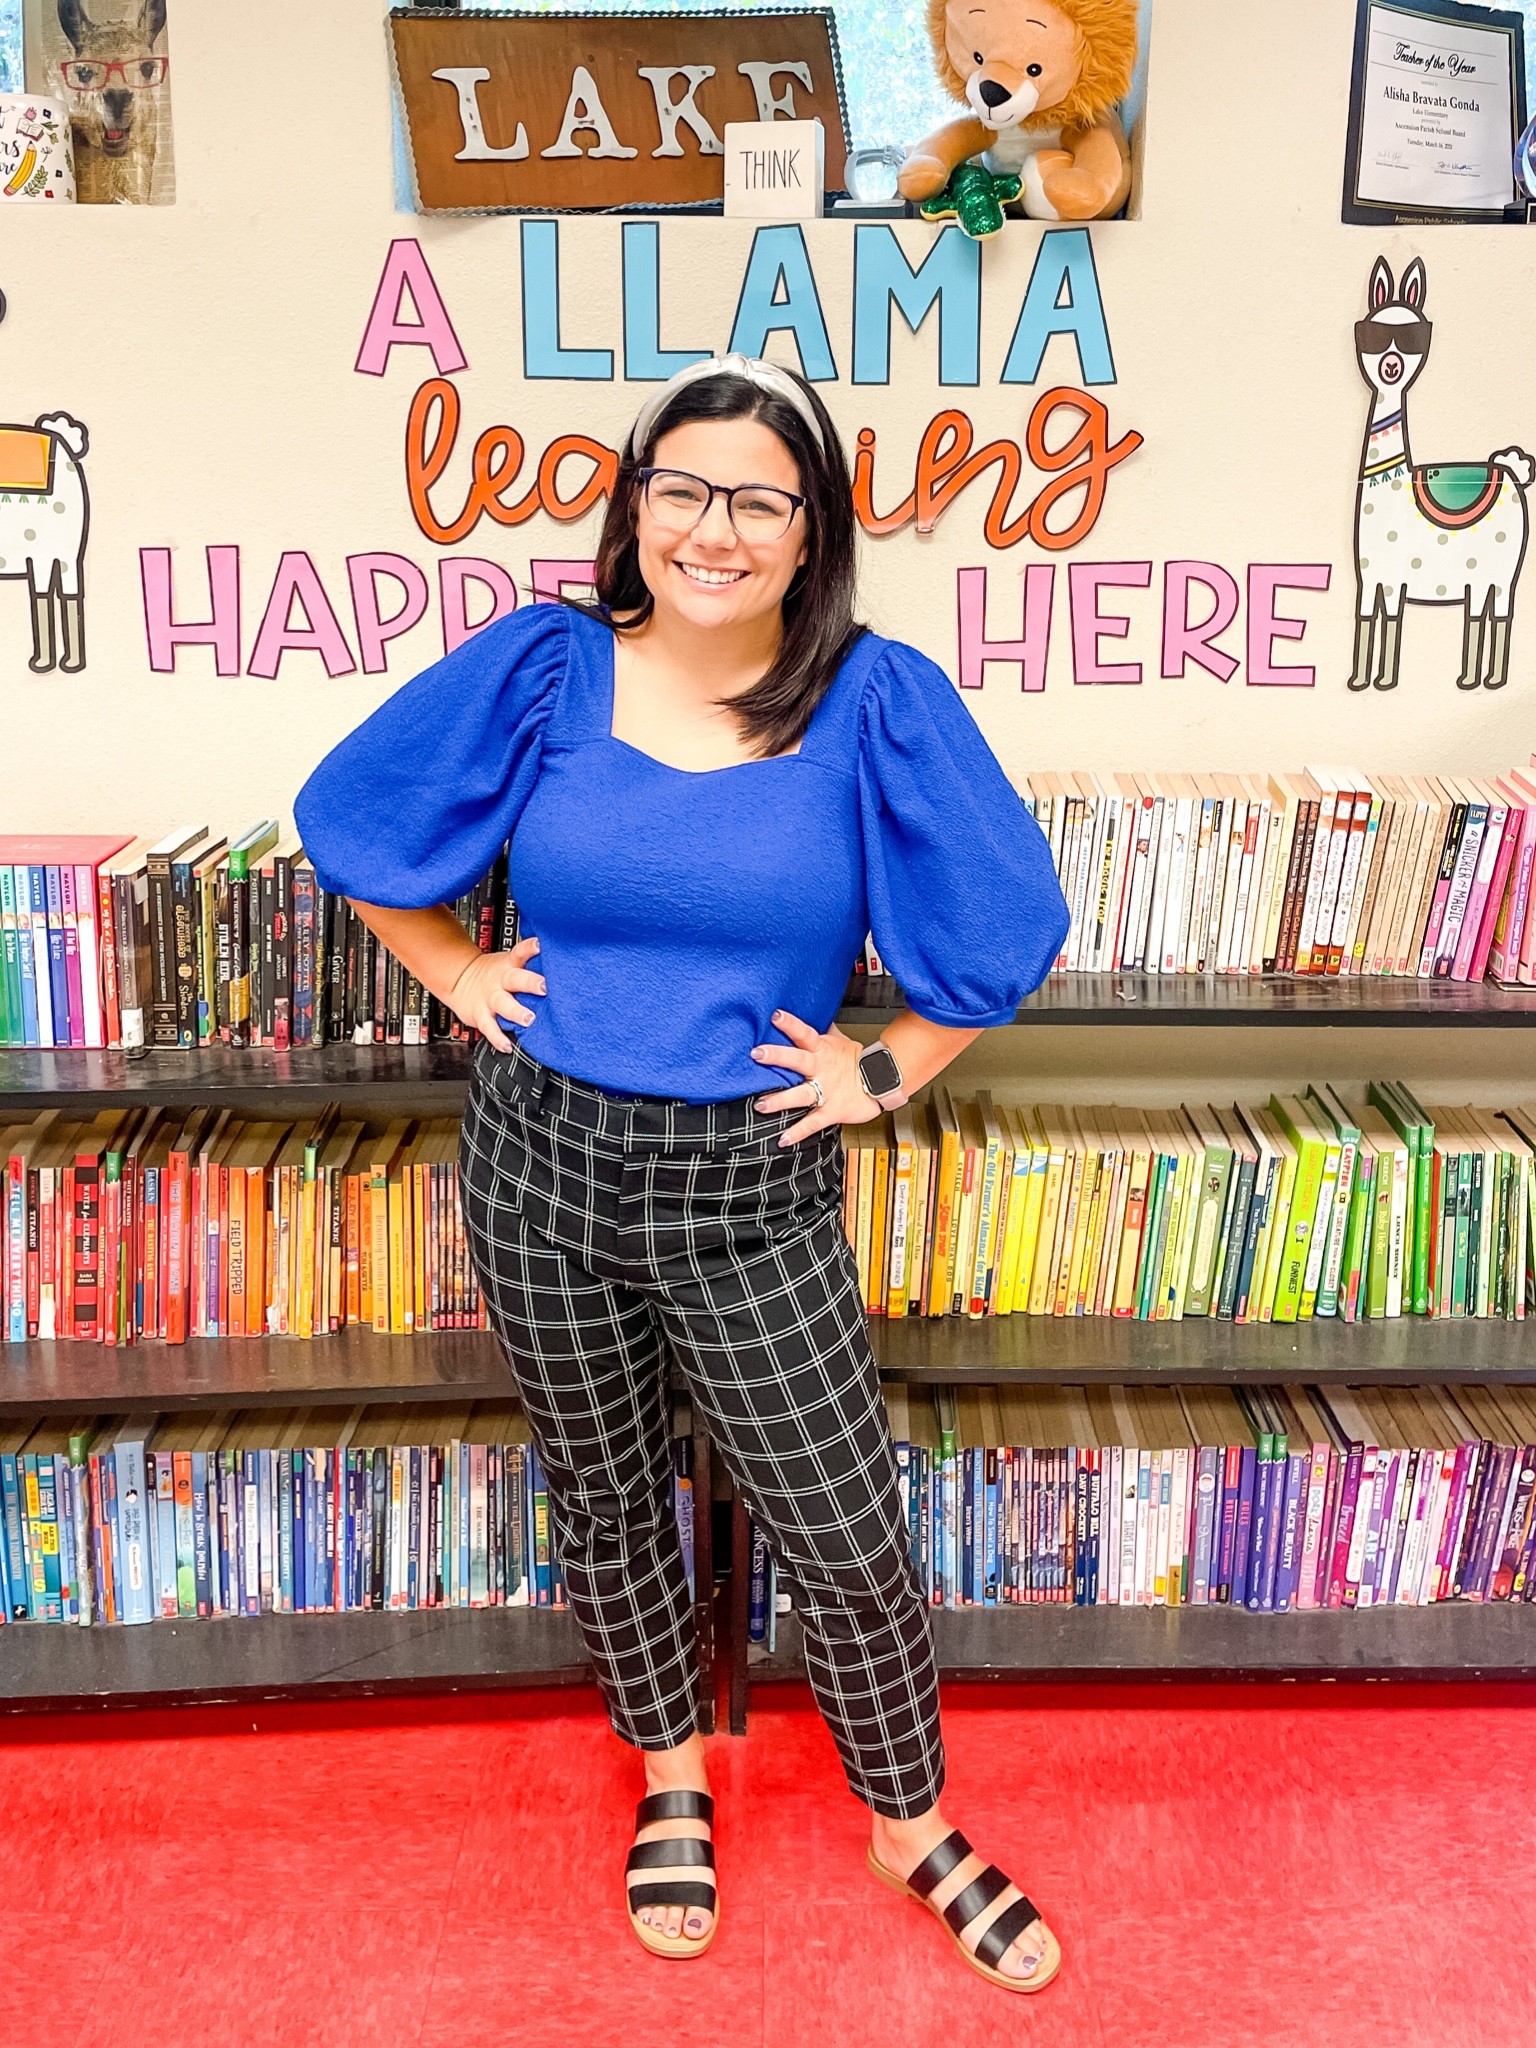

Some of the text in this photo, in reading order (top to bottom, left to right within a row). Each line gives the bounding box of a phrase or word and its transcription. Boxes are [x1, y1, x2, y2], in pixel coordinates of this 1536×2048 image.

[1393, 41, 1476, 77] Teacher of the Year
[1383, 85, 1480, 112] Alisha Bravata Gonda
[739, 148, 802, 190] THINK
[354, 218, 1118, 388] A LLAMA
[405, 377, 1144, 551] leaing
[957, 561, 1333, 692] HERE
[1458, 839, 1478, 879] SNICKER
[1100, 860, 1111, 894] Magic
[1448, 890, 1467, 923] MAGIC
[219, 924, 228, 958] STOLEN
[220, 961, 230, 984] GIRL
[331, 955, 344, 983] GIVER
[179, 985, 190, 1020] Shadows
[409, 988, 418, 1008] Time
[987, 1143, 998, 1160] The
[954, 1162, 962, 1192] CREECH
[987, 1162, 996, 1177] Old
[982, 1180, 994, 1218] Farmer's
[29, 1210, 37, 1248] TITANIC
[81, 1211, 90, 1222] for
[949, 1219, 958, 1238] LOVE
[1067, 1202, 1077, 1231] handful
[1376, 1210, 1388, 1231] Ruby
[10, 1187, 23, 1317] TELL ME EVERYTHING
[170, 1181, 180, 1293] THE TRADING GAME
[948, 1242, 956, 1261] THAT
[978, 1221, 991, 1258] Almanac
[230, 1220, 242, 1295] FIELD TRIPPED
[976, 1261, 986, 1273] for
[974, 1276, 985, 1296] Kids
[1288, 1261, 1300, 1294] FUNNIEST
[194, 1493, 205, 1509] How
[987, 1501, 995, 1517] How
[1078, 1473, 1086, 1542] DAVY CROCKETT
[1090, 1475, 1100, 1537] BUFFALO BILL
[1224, 1499, 1235, 1524] HOLES
[1240, 1501, 1249, 1526] HOLES
[1282, 1459, 1299, 1569] SEWELL BLACK BEAUTY
[680, 1495, 692, 1551] GHOSTS
[987, 1518, 995, 1526] To
[987, 1527, 995, 1542] Steal
[1124, 1520, 1135, 1543] STRAYS
[1337, 1505, 1354, 1544] Braced
[30, 1521, 46, 1593] RULES
[987, 1549, 995, 1563] Dog
[1123, 1544, 1134, 1557] LIKE
